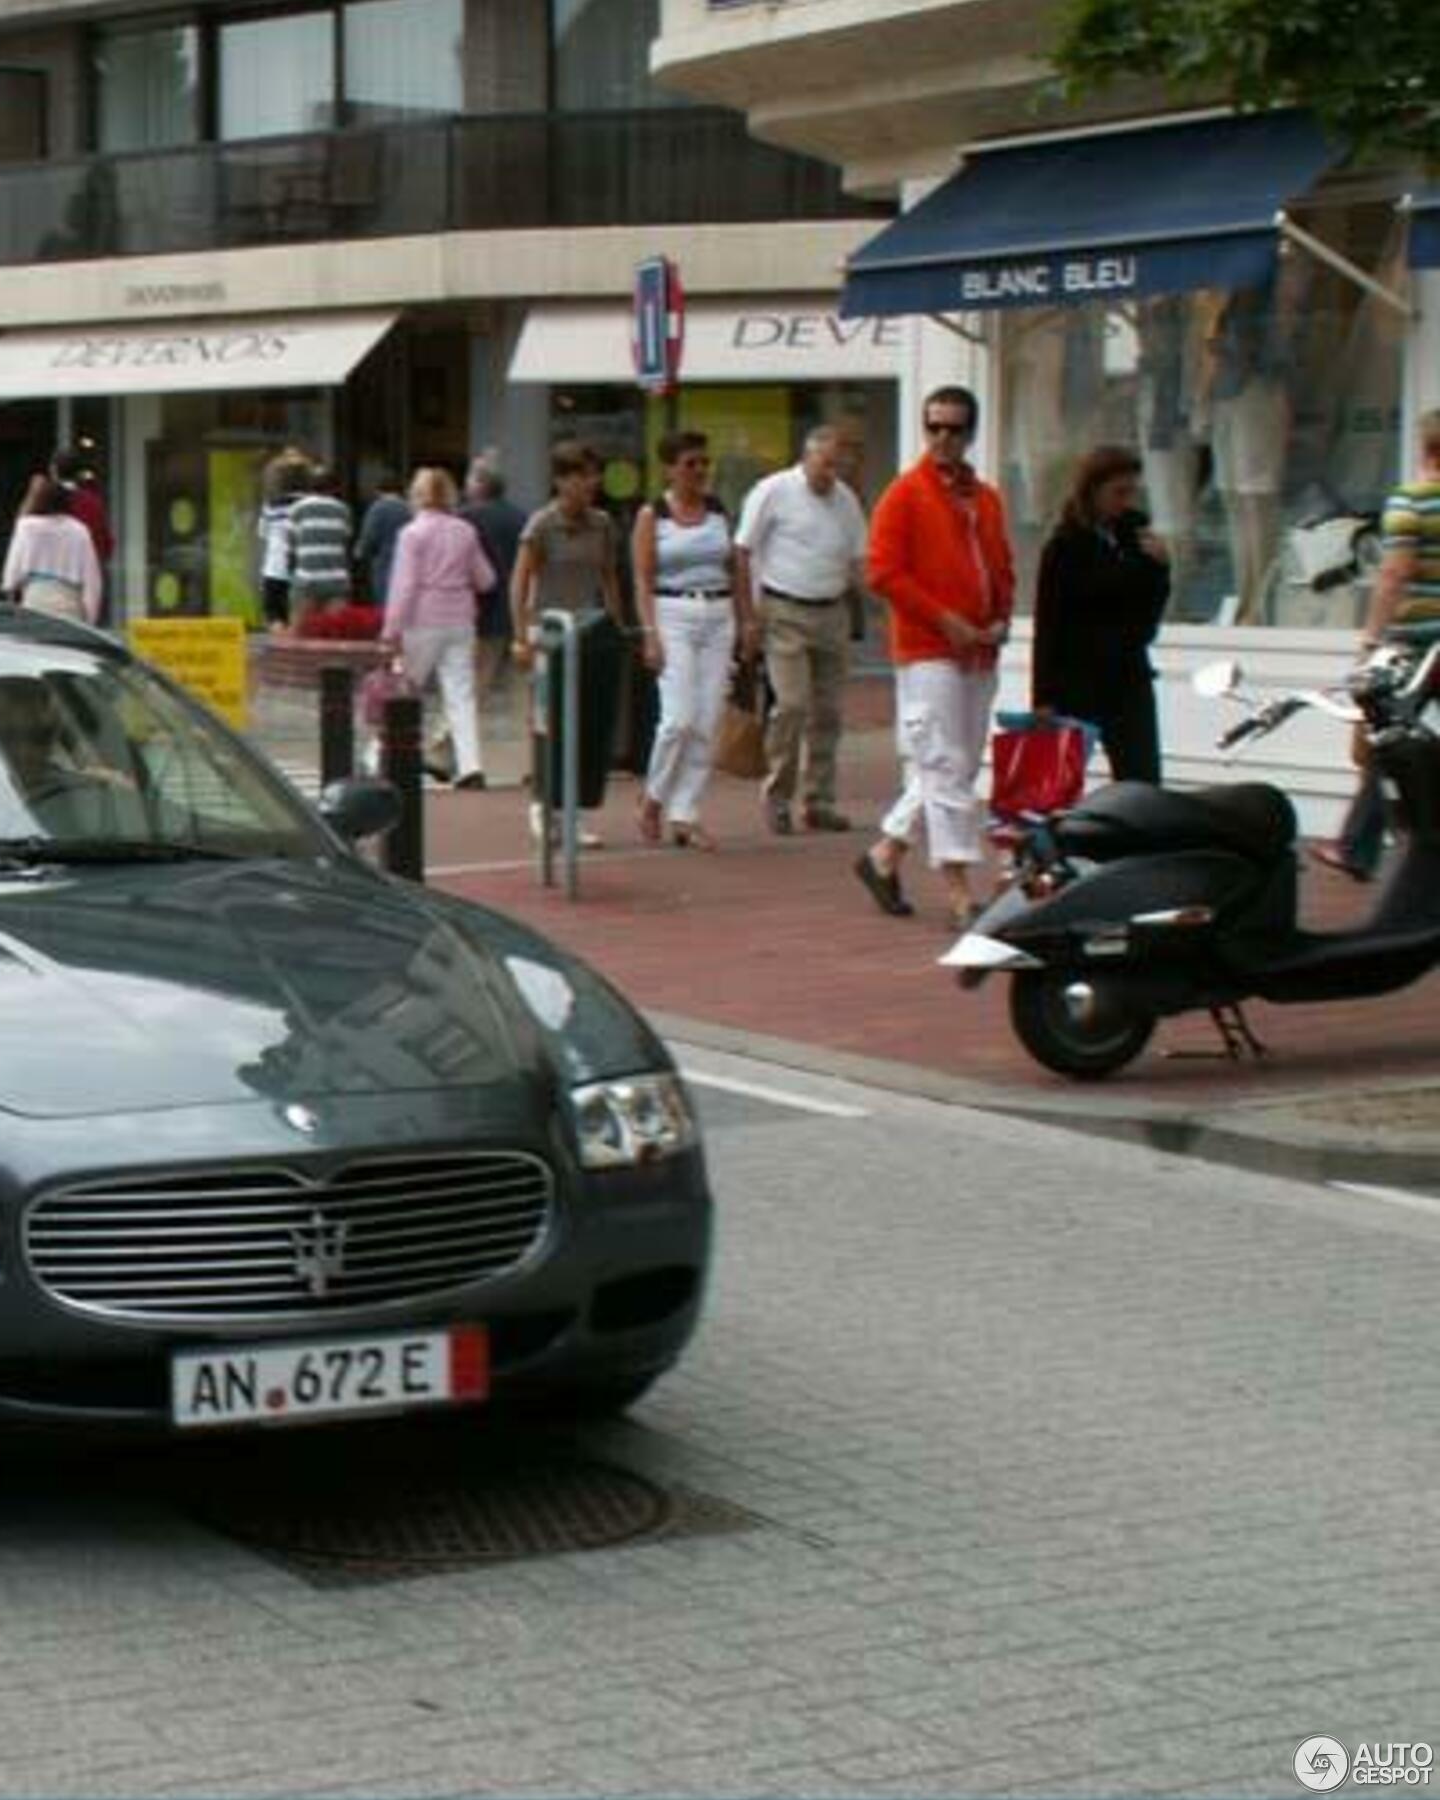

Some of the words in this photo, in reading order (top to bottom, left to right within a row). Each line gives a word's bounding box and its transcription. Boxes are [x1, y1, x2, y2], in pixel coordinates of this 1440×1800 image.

[962, 264, 1049, 299] BLANC
[1063, 256, 1136, 292] BLEU
[189, 1360, 257, 1412] AN
[292, 1348, 385, 1404] 672
[402, 1341, 430, 1393] E
